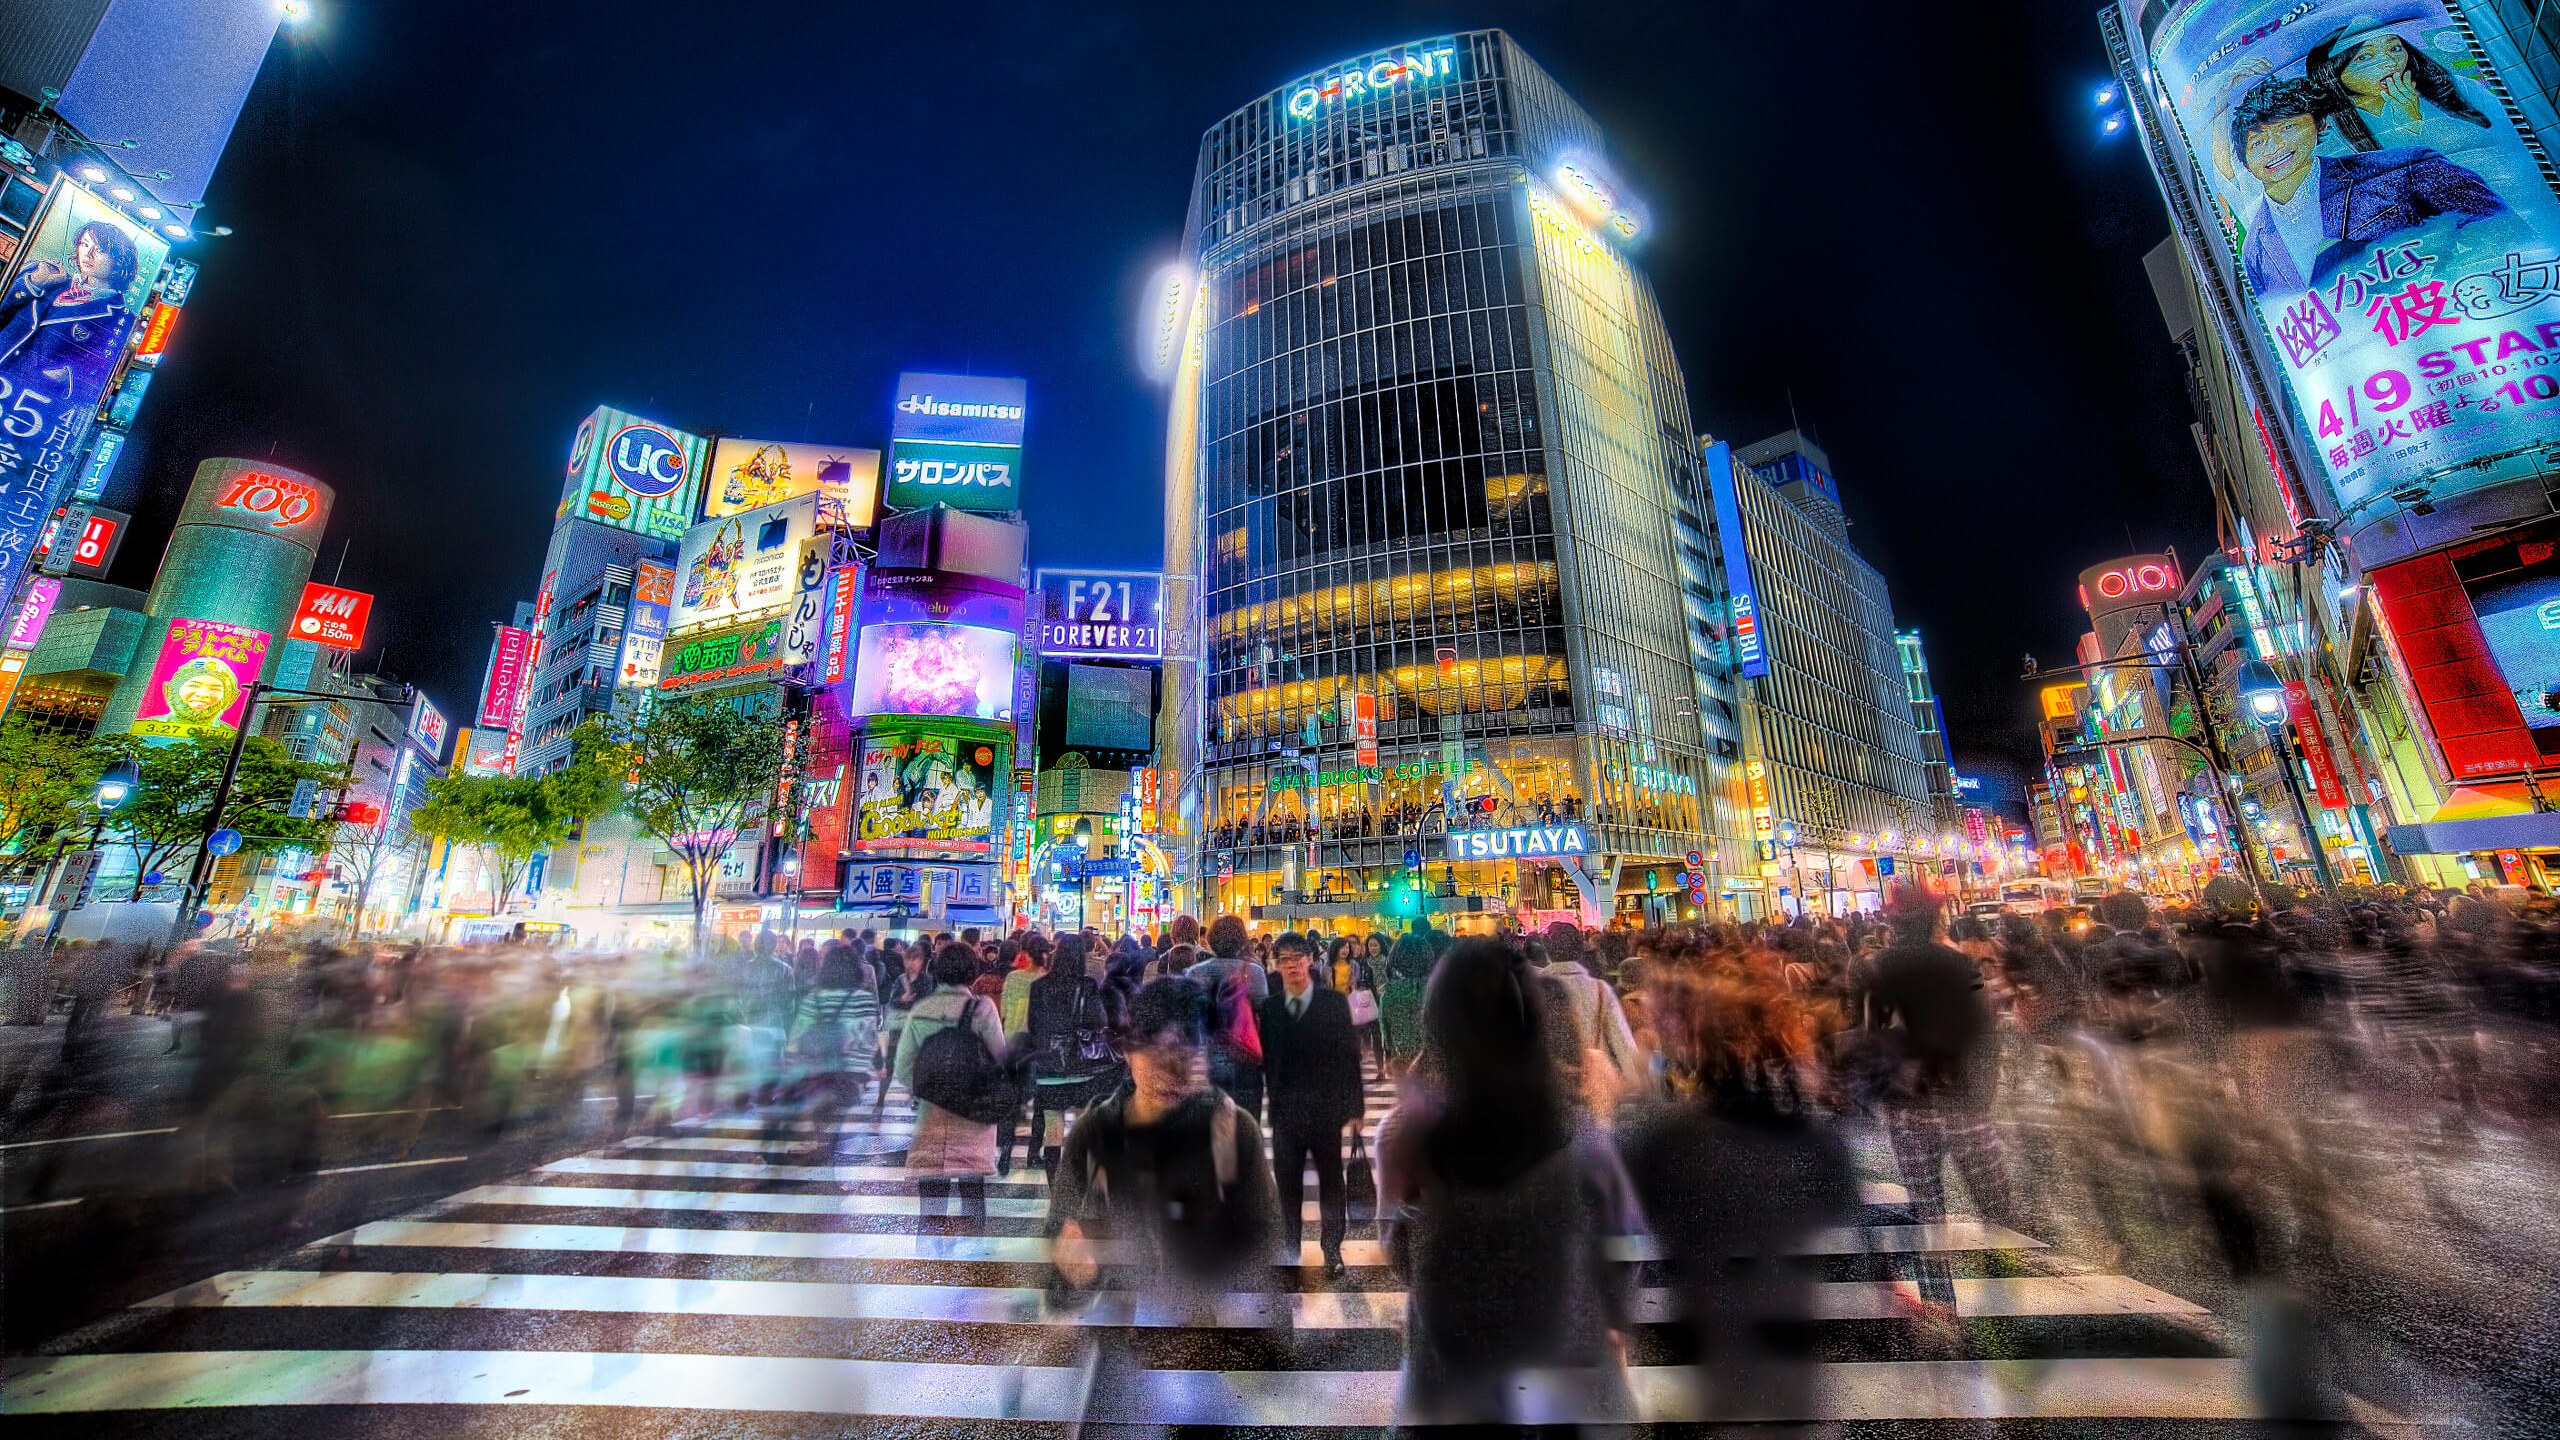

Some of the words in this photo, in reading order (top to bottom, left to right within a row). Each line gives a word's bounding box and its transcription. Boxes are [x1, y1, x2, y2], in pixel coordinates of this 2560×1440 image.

[897, 394, 1023, 421] Hisamitsu
[2318, 370, 2411, 440] 4/9
[895, 458, 1012, 488] サロンパス
[218, 478, 316, 527] 109
[587, 497, 631, 514] MasterCard
[652, 511, 685, 531] VISA
[50, 509, 86, 567] 渋谷駅前ビル
[904, 574, 934, 583] チャンネル
[310, 590, 359, 620] H&M
[788, 549, 825, 660] もんじゃ
[1067, 580, 1132, 622] F21
[320, 628, 354, 641] 150m
[323, 619, 348, 631] この先
[827, 571, 851, 677] 三千里薬品
[1042, 624, 1130, 647] FOREVER
[1135, 626, 1155, 648] 21
[1732, 593, 1761, 663] SEIBU
[170, 626, 266, 653] ラストベスト
[181, 641, 249, 663] アルバム
[628, 636, 663, 653] 夜11時
[632, 650, 655, 663] まで
[484, 629, 522, 721] Essential
[1018, 676, 1033, 723] neon
[145, 723, 181, 735] 3.27
[2299, 717, 2338, 800] 三菱東京UFJ銀行
[1270, 765, 1384, 792] STARBUCKS
[1395, 758, 1475, 780] COFFEE
[1631, 764, 1696, 796] TSUTAYA
[927, 828, 950, 840] NOW
[1452, 826, 1584, 857] TSUTAYA
[852, 868, 983, 900] 大盛堂店
